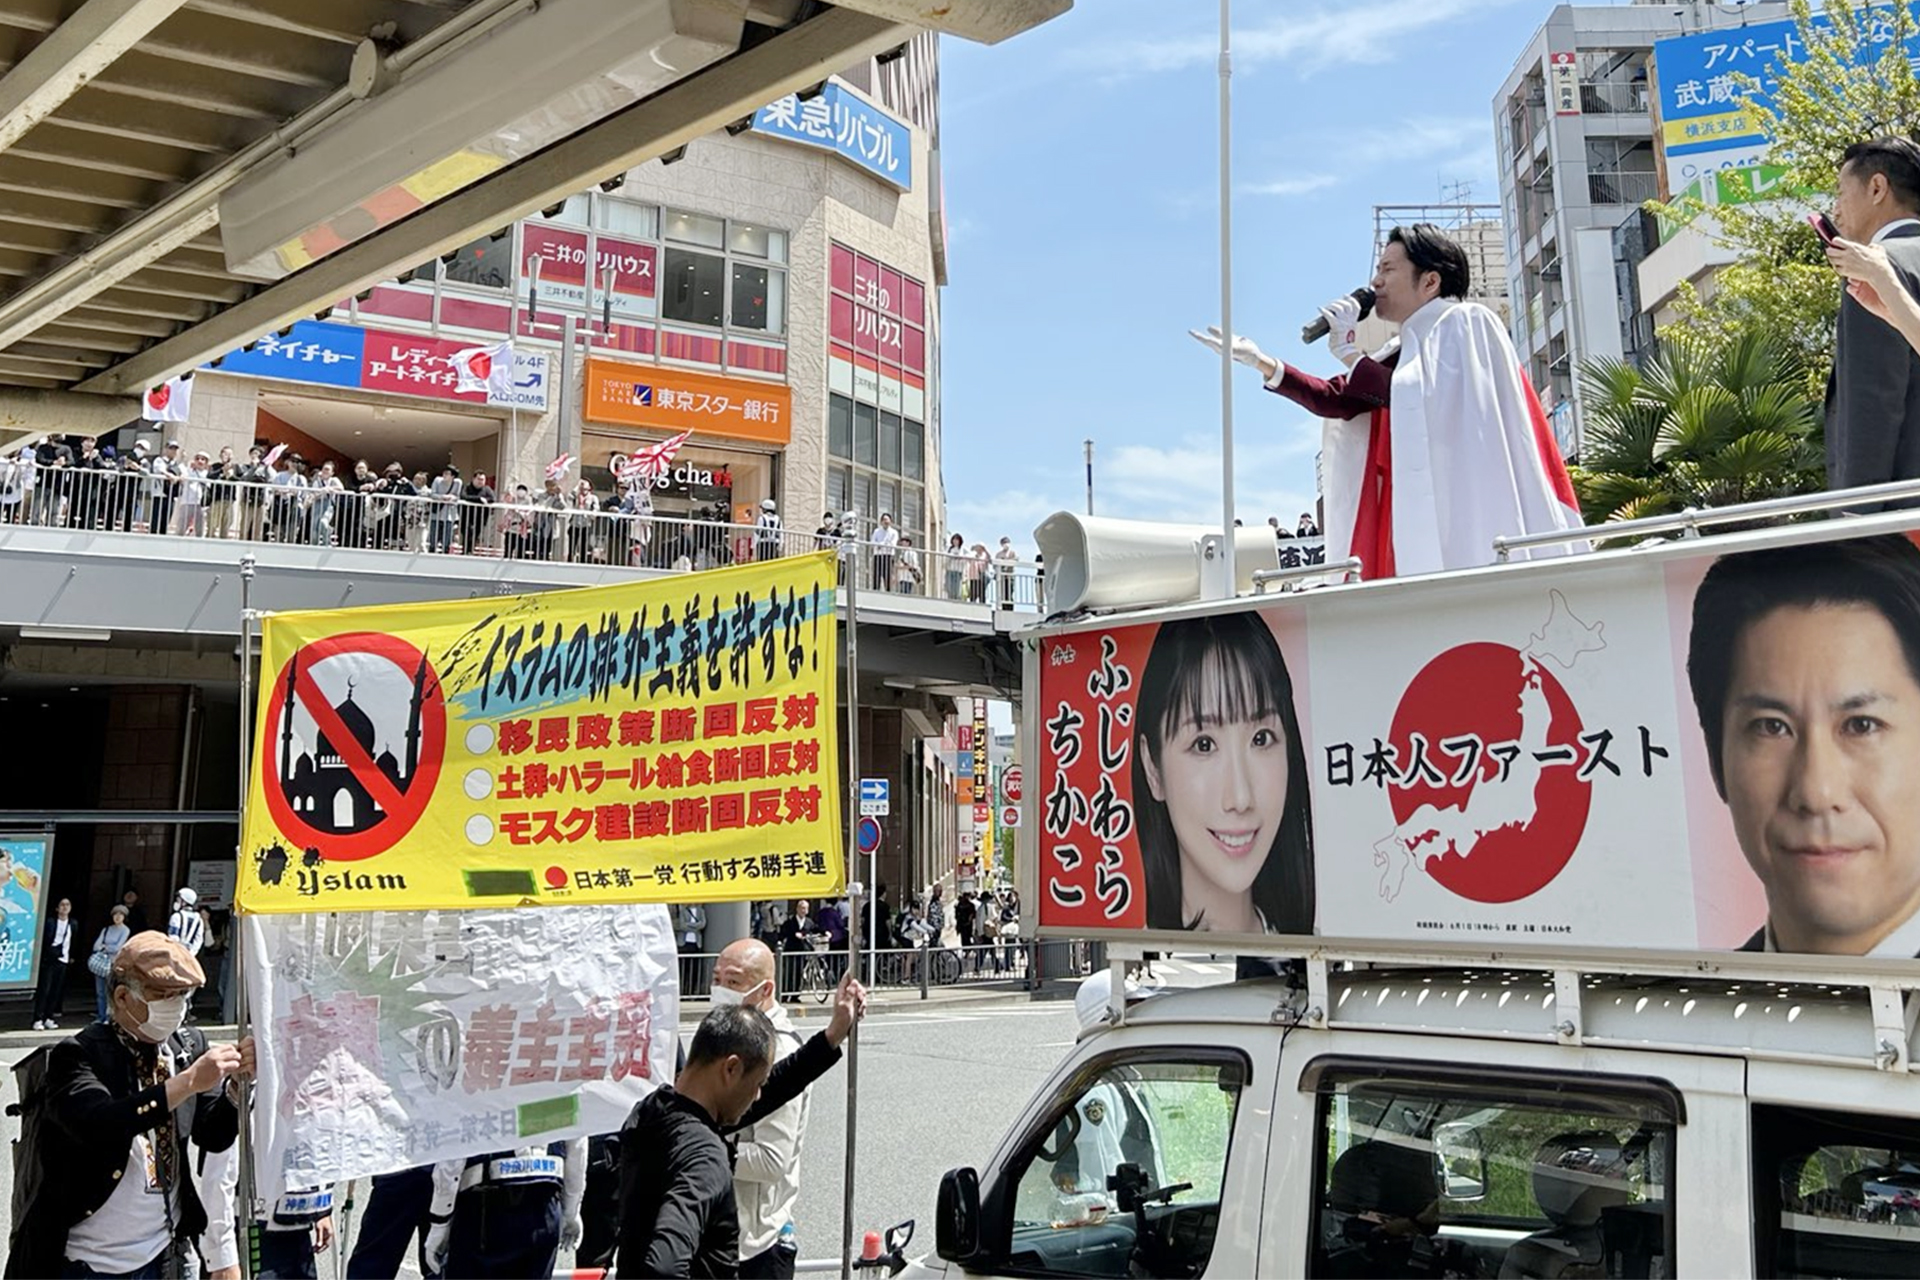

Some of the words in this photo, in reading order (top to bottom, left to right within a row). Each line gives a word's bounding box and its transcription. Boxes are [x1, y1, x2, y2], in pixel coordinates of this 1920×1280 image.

[763, 93, 899, 171] 東急リバブル
[1685, 117, 1747, 138] 横浜支店
[541, 241, 651, 277] 三井のリハウス
[855, 275, 890, 310] 三井の
[855, 306, 902, 349] リハウス
[241, 334, 356, 364] ネイチャー
[369, 361, 458, 386] アートネイチ
[603, 379, 633, 390] TOKYO
[656, 388, 780, 424] 東京スター銀行
[477, 580, 820, 711] イスラムの排外主義を許すな！
[1051, 644, 1076, 666] 弁士
[497, 692, 819, 755] 移民政策断固反対
[497, 738, 821, 799] 土葬・ハラール給食断固反対
[1088, 635, 1133, 918] ふじわら
[1324, 725, 1670, 788] 日本人ファースト
[499, 784, 822, 845] モスク建設断固反対
[1046, 701, 1087, 907] ちかこ
[574, 864, 674, 890] 日本第一党
[680, 850, 827, 884] 行動する勝手連
